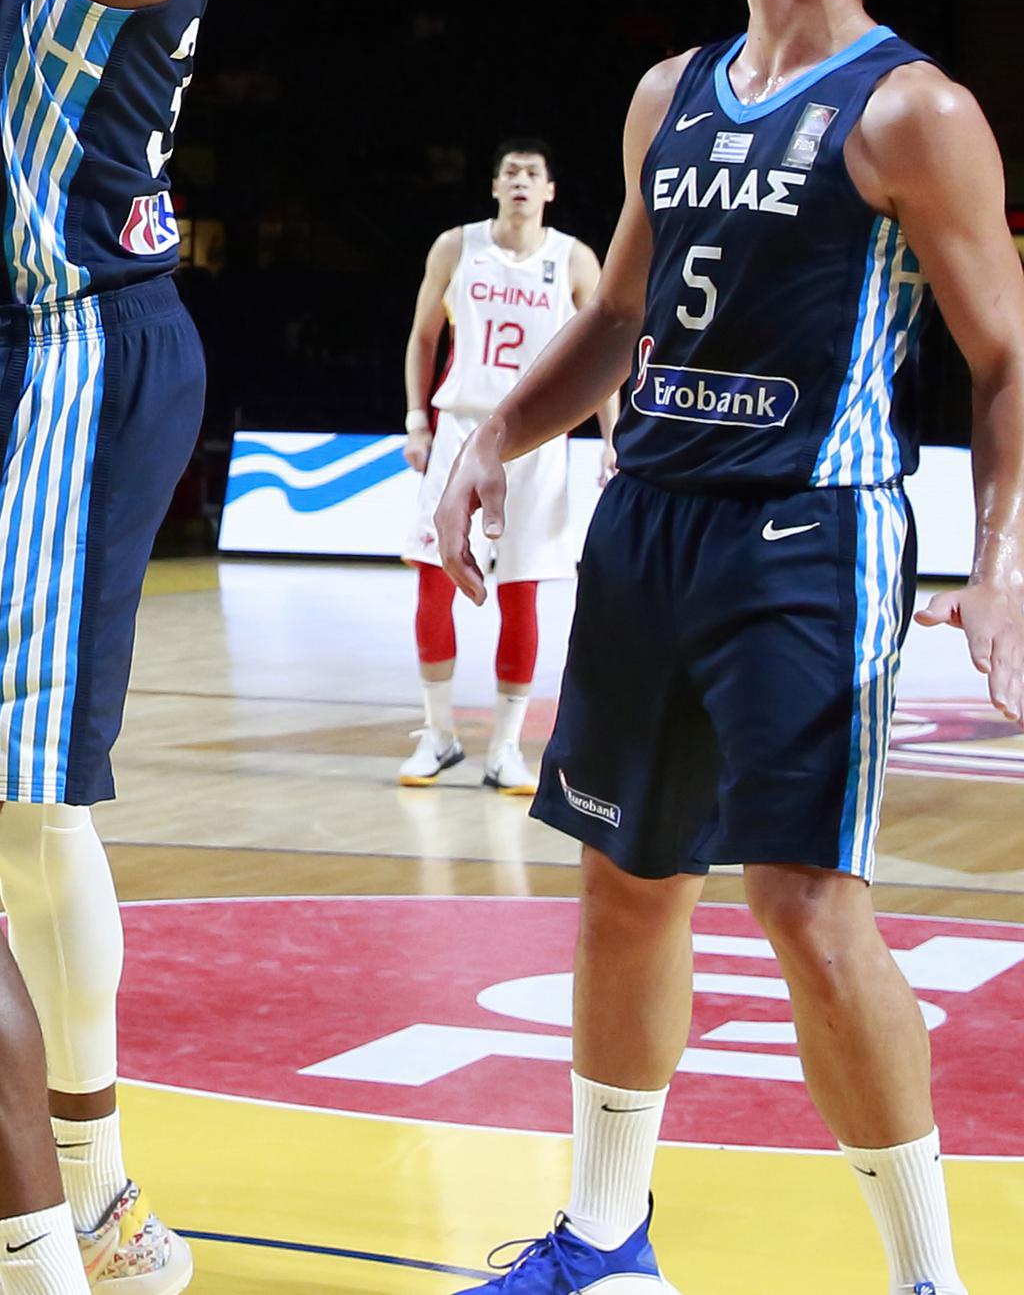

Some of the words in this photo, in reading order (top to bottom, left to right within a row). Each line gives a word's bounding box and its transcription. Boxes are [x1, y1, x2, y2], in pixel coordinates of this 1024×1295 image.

[652, 166, 807, 217] ΕΛΛΑΣ
[470, 282, 551, 310] CHINA
[676, 245, 723, 331] 5
[482, 319, 526, 370] 12
